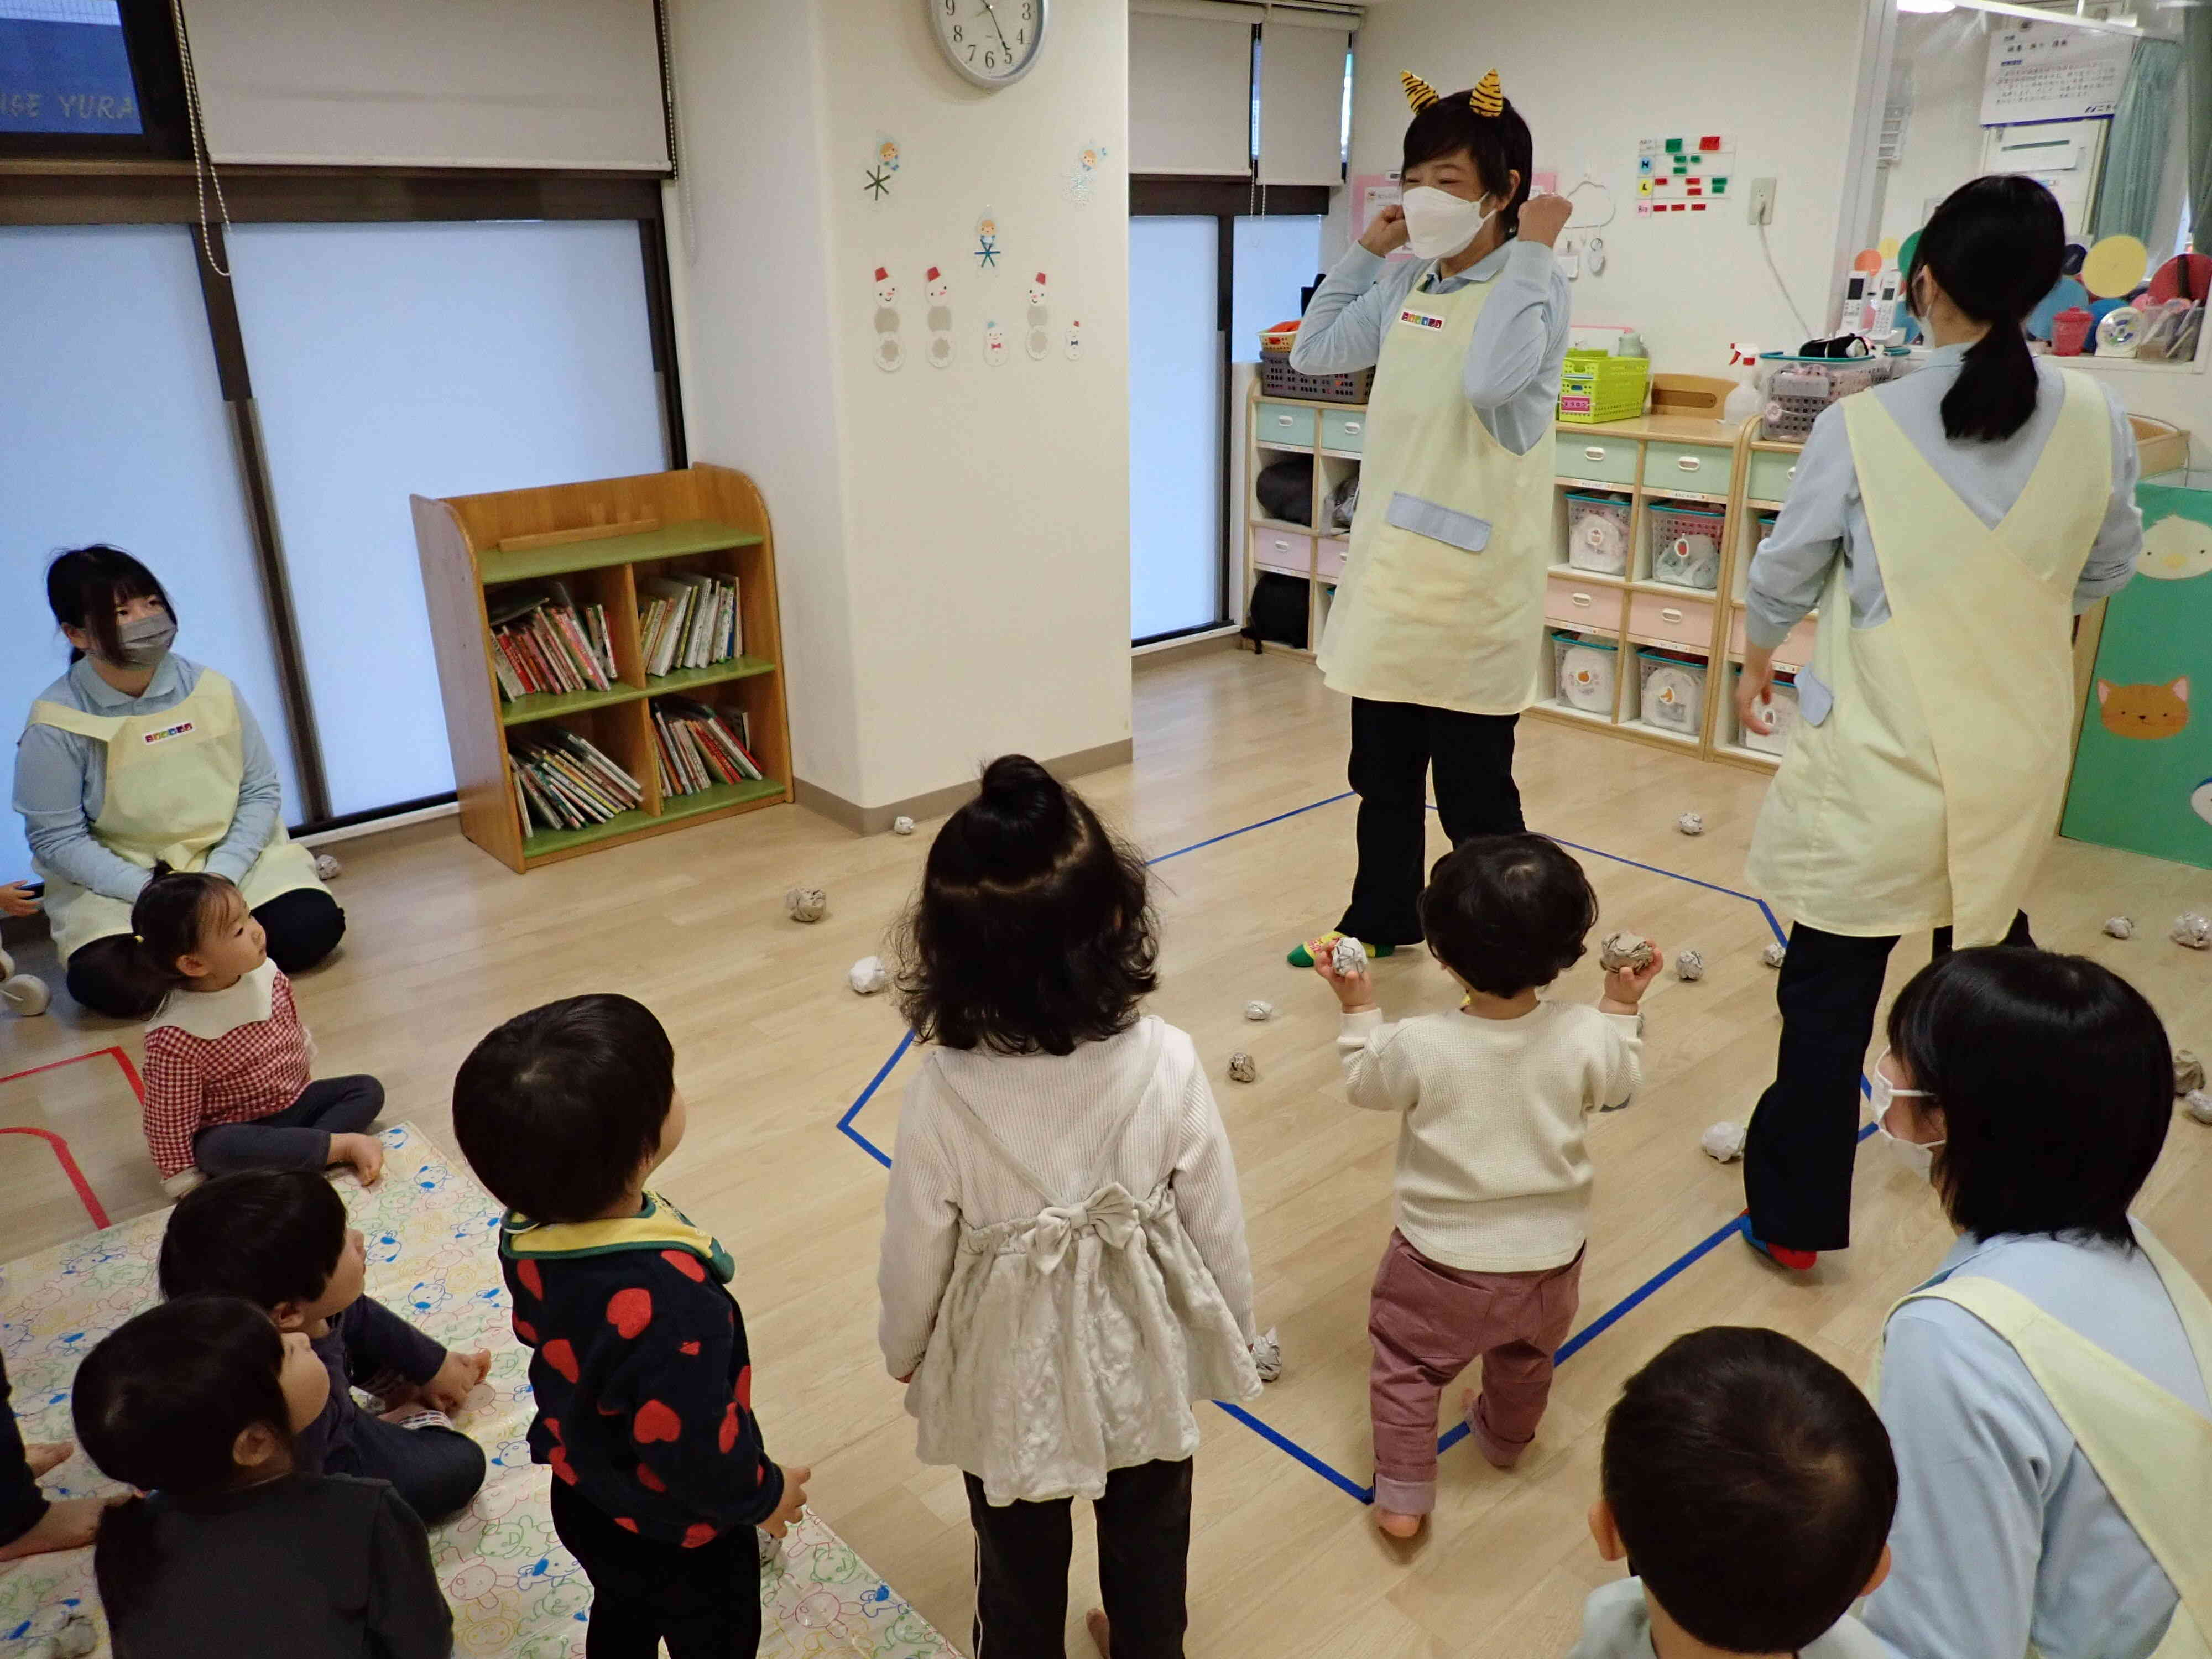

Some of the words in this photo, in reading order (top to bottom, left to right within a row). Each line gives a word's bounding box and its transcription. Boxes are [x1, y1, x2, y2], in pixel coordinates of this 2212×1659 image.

[946, 0, 954, 15] 9
[1022, 3, 1031, 20] 3
[954, 25, 962, 42] 8
[1017, 28, 1024, 44] 4
[968, 45, 976, 61] 7
[985, 51, 994, 68] 6
[1004, 48, 1012, 64] 5
